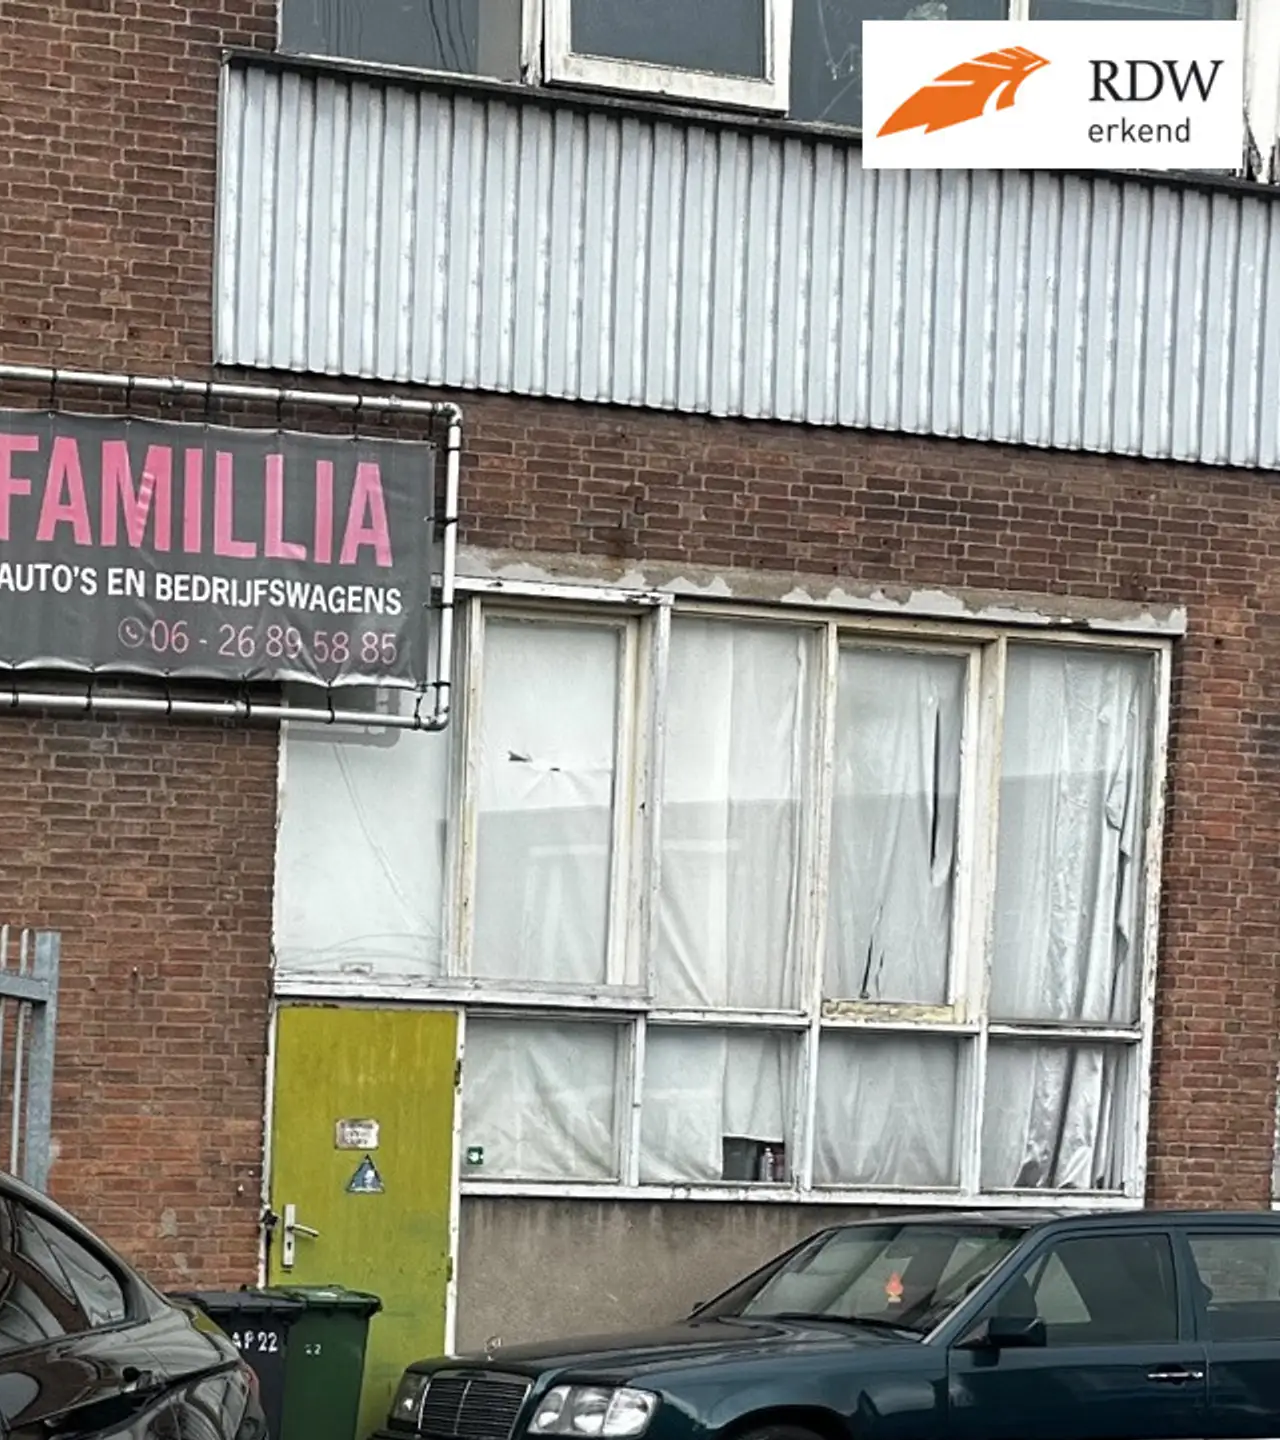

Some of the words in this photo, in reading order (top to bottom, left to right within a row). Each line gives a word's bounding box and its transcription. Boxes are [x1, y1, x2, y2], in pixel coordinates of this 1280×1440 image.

[107, 568, 146, 599] EN
[155, 573, 403, 616] BEDRIJFSWAGENS
[151, 617, 191, 653] 06
[218, 624, 257, 658] 26
[265, 626, 303, 660] 89
[313, 630, 351, 664] 58
[360, 632, 398, 665] 85
[258, 1331, 278, 1352] 22
